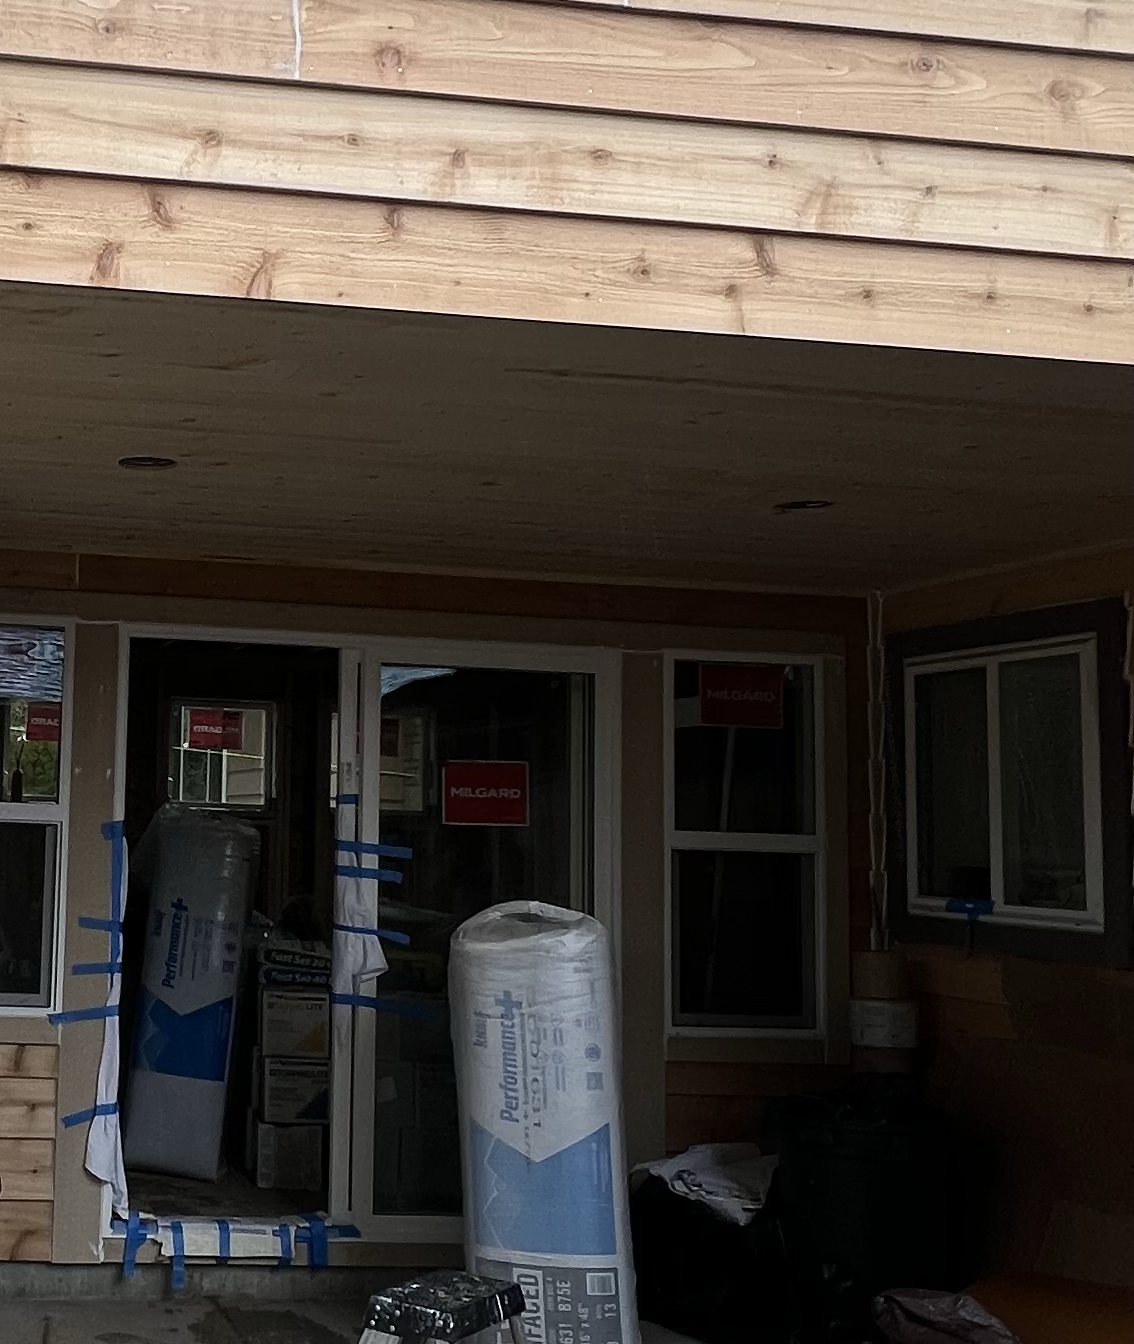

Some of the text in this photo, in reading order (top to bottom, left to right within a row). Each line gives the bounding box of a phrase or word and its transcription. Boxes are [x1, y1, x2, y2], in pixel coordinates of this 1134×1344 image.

[706, 689, 776, 703] MILGARD
[450, 787, 521, 799] MILGARD
[604, 1303, 617, 1318] 13
